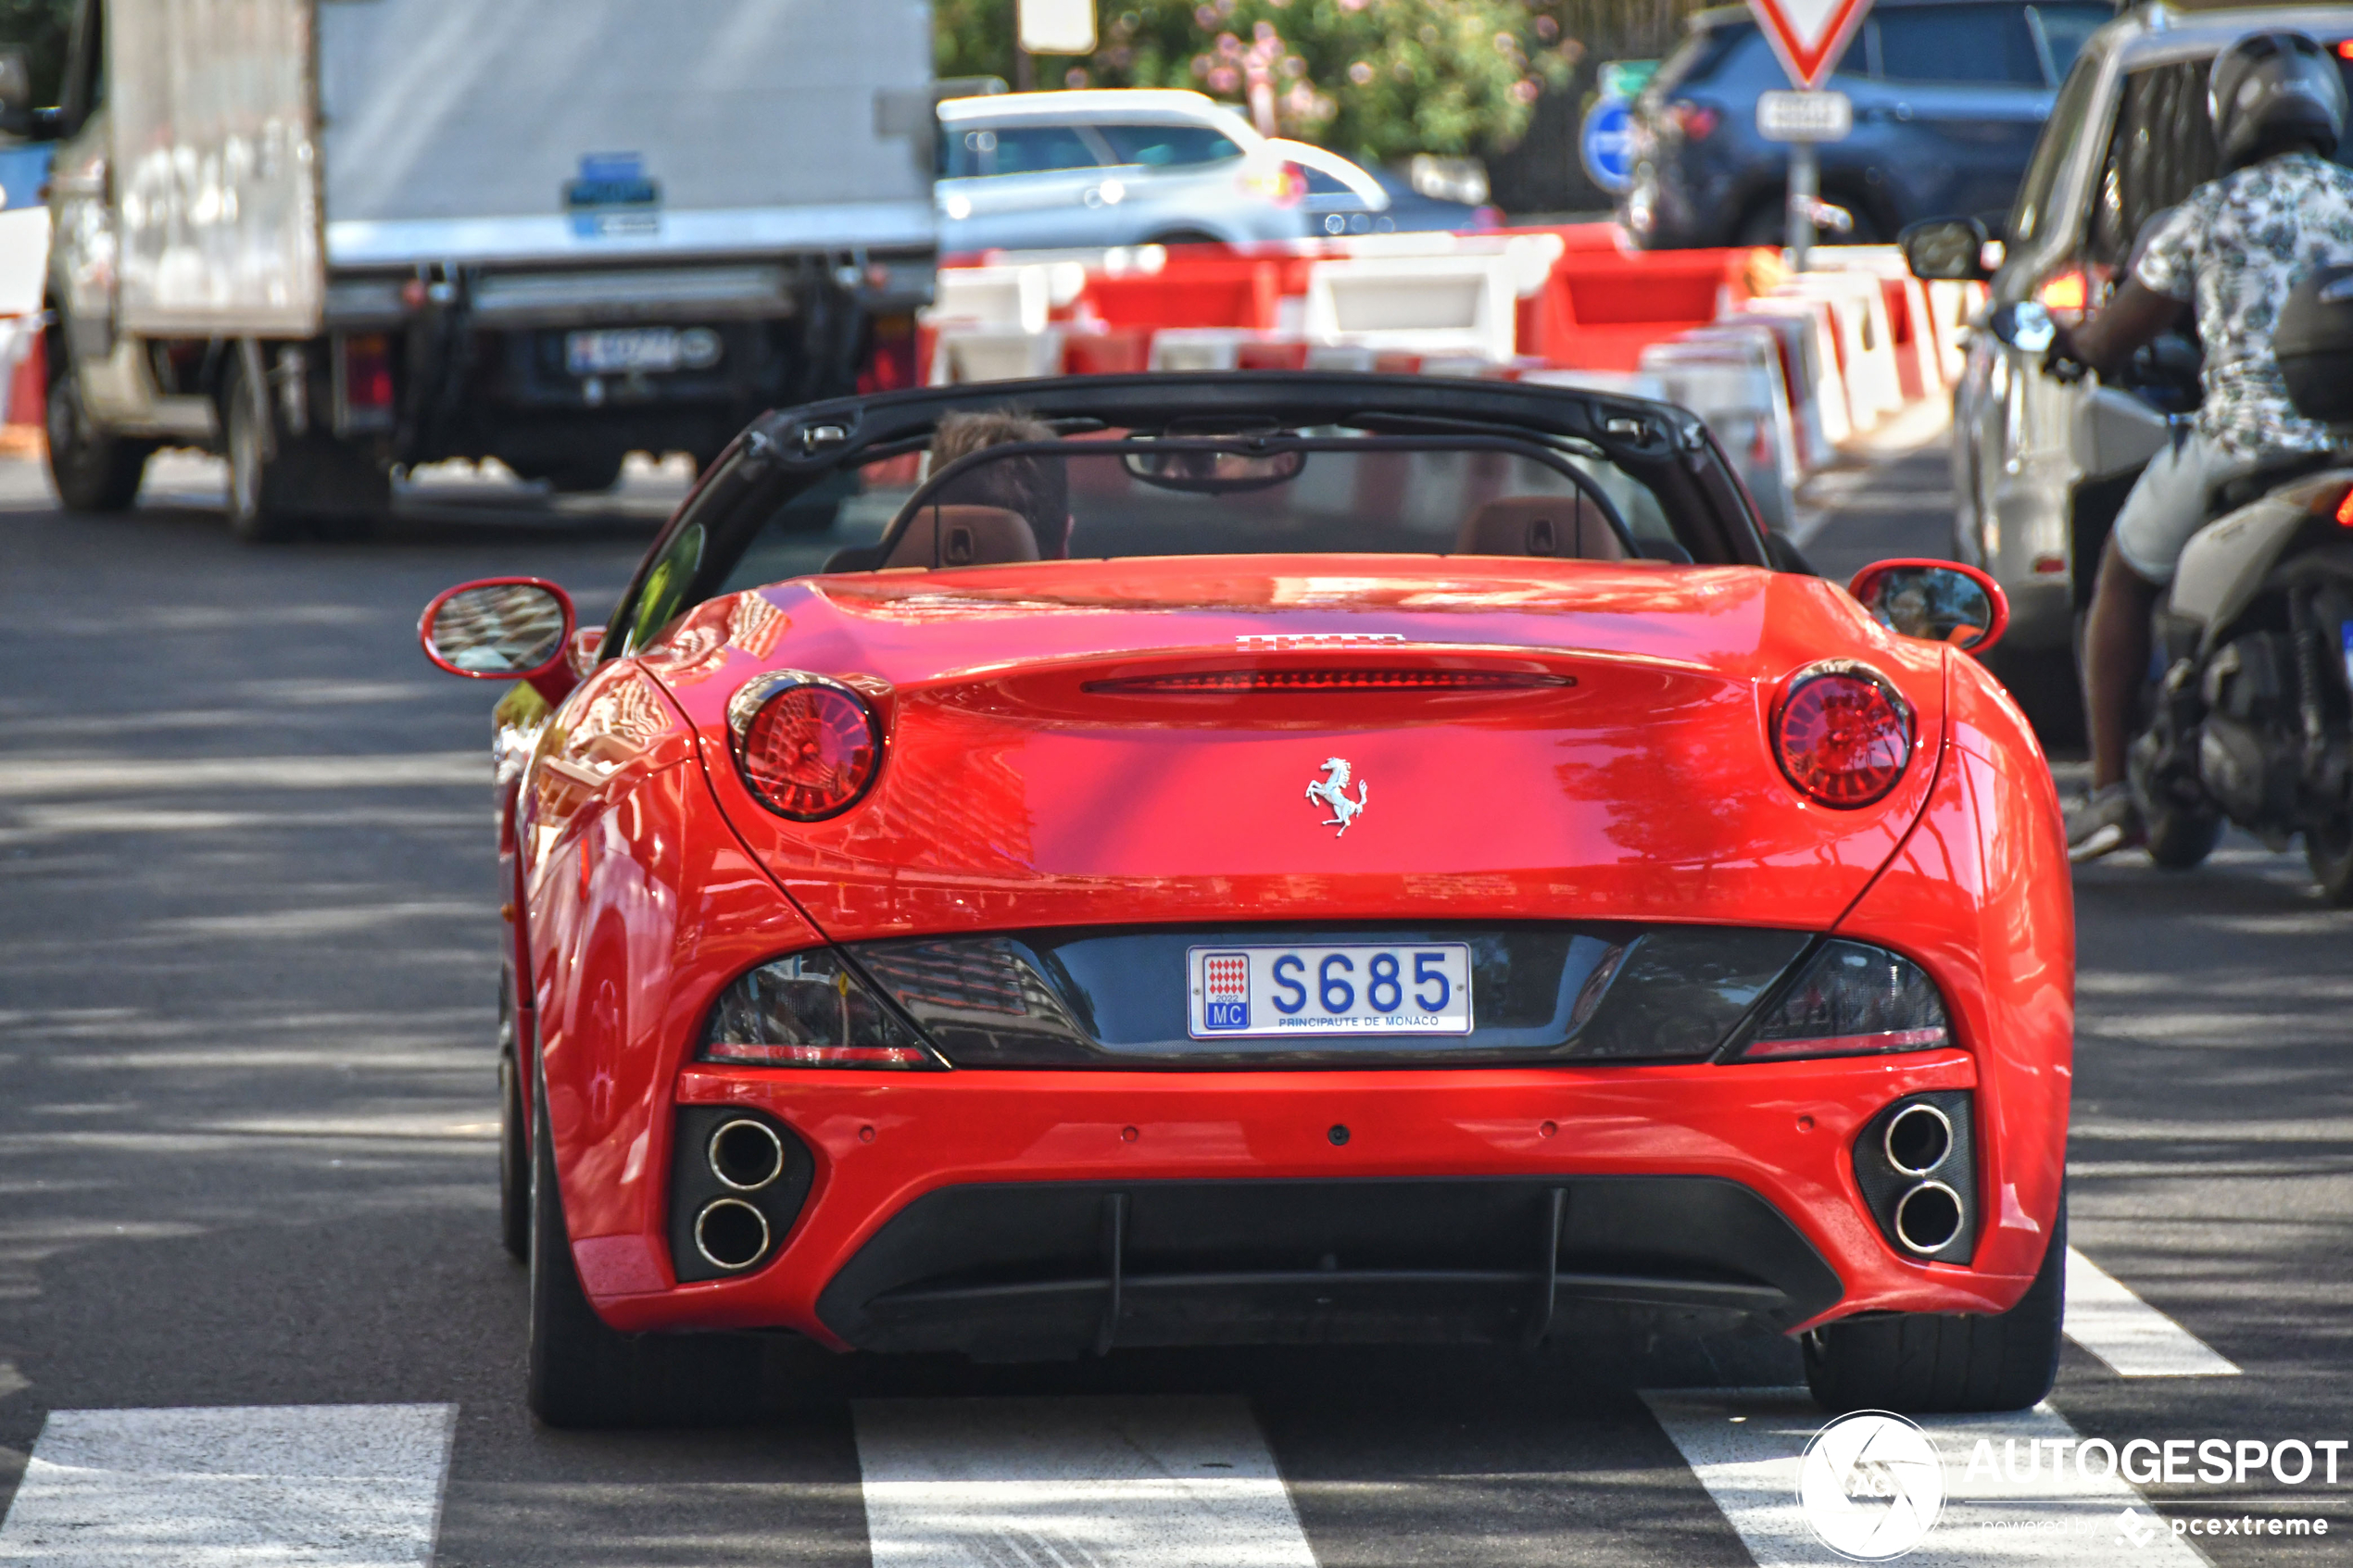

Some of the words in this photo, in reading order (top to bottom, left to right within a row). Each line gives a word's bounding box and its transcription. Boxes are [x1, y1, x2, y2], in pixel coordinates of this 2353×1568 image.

[1272, 952, 1451, 1014] S685
[1215, 994, 1239, 1003] 2022
[1214, 1005, 1242, 1024] MC
[1278, 1016, 1359, 1027] PRINCIPAUTE
[1364, 1016, 1380, 1026] DE
[1385, 1015, 1440, 1026] MONACO
